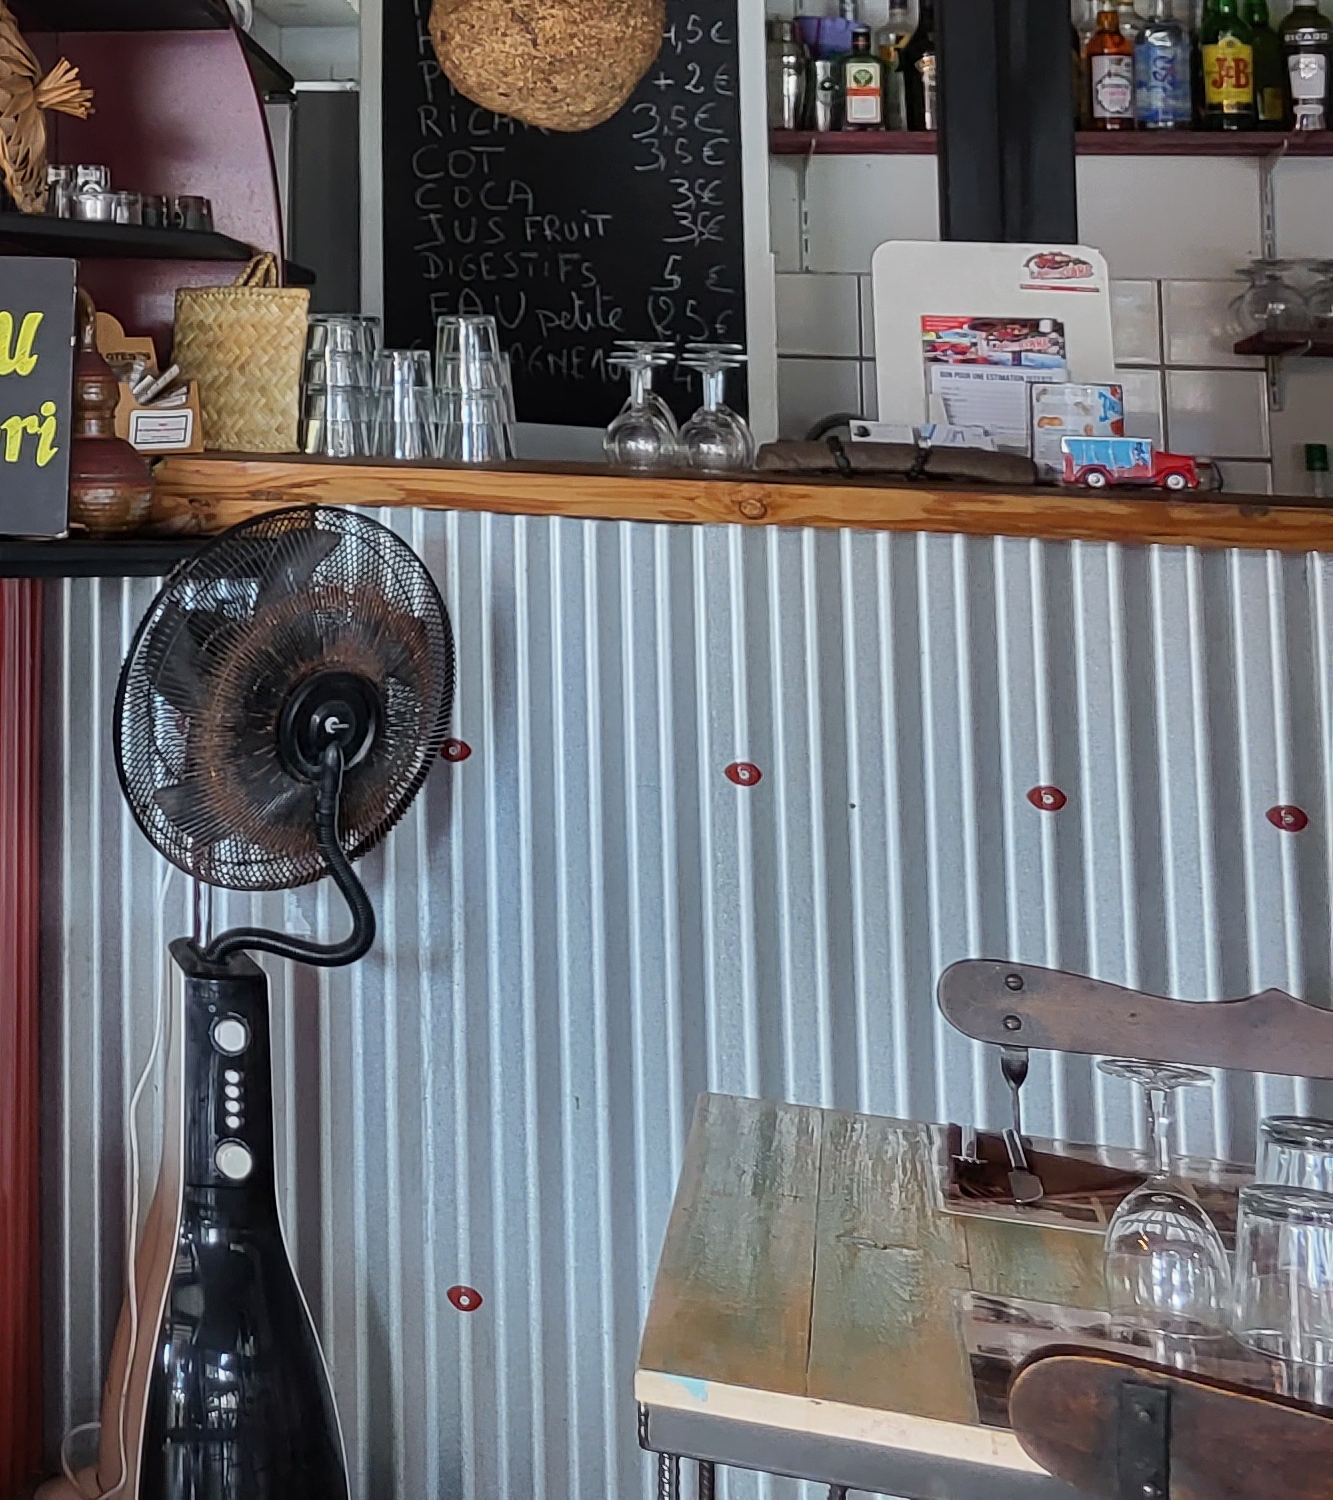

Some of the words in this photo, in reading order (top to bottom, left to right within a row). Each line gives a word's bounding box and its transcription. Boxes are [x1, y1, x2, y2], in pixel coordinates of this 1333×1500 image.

[412, 144, 506, 179] COT
[414, 179, 534, 215] COCA
[414, 213, 506, 251] JUS
